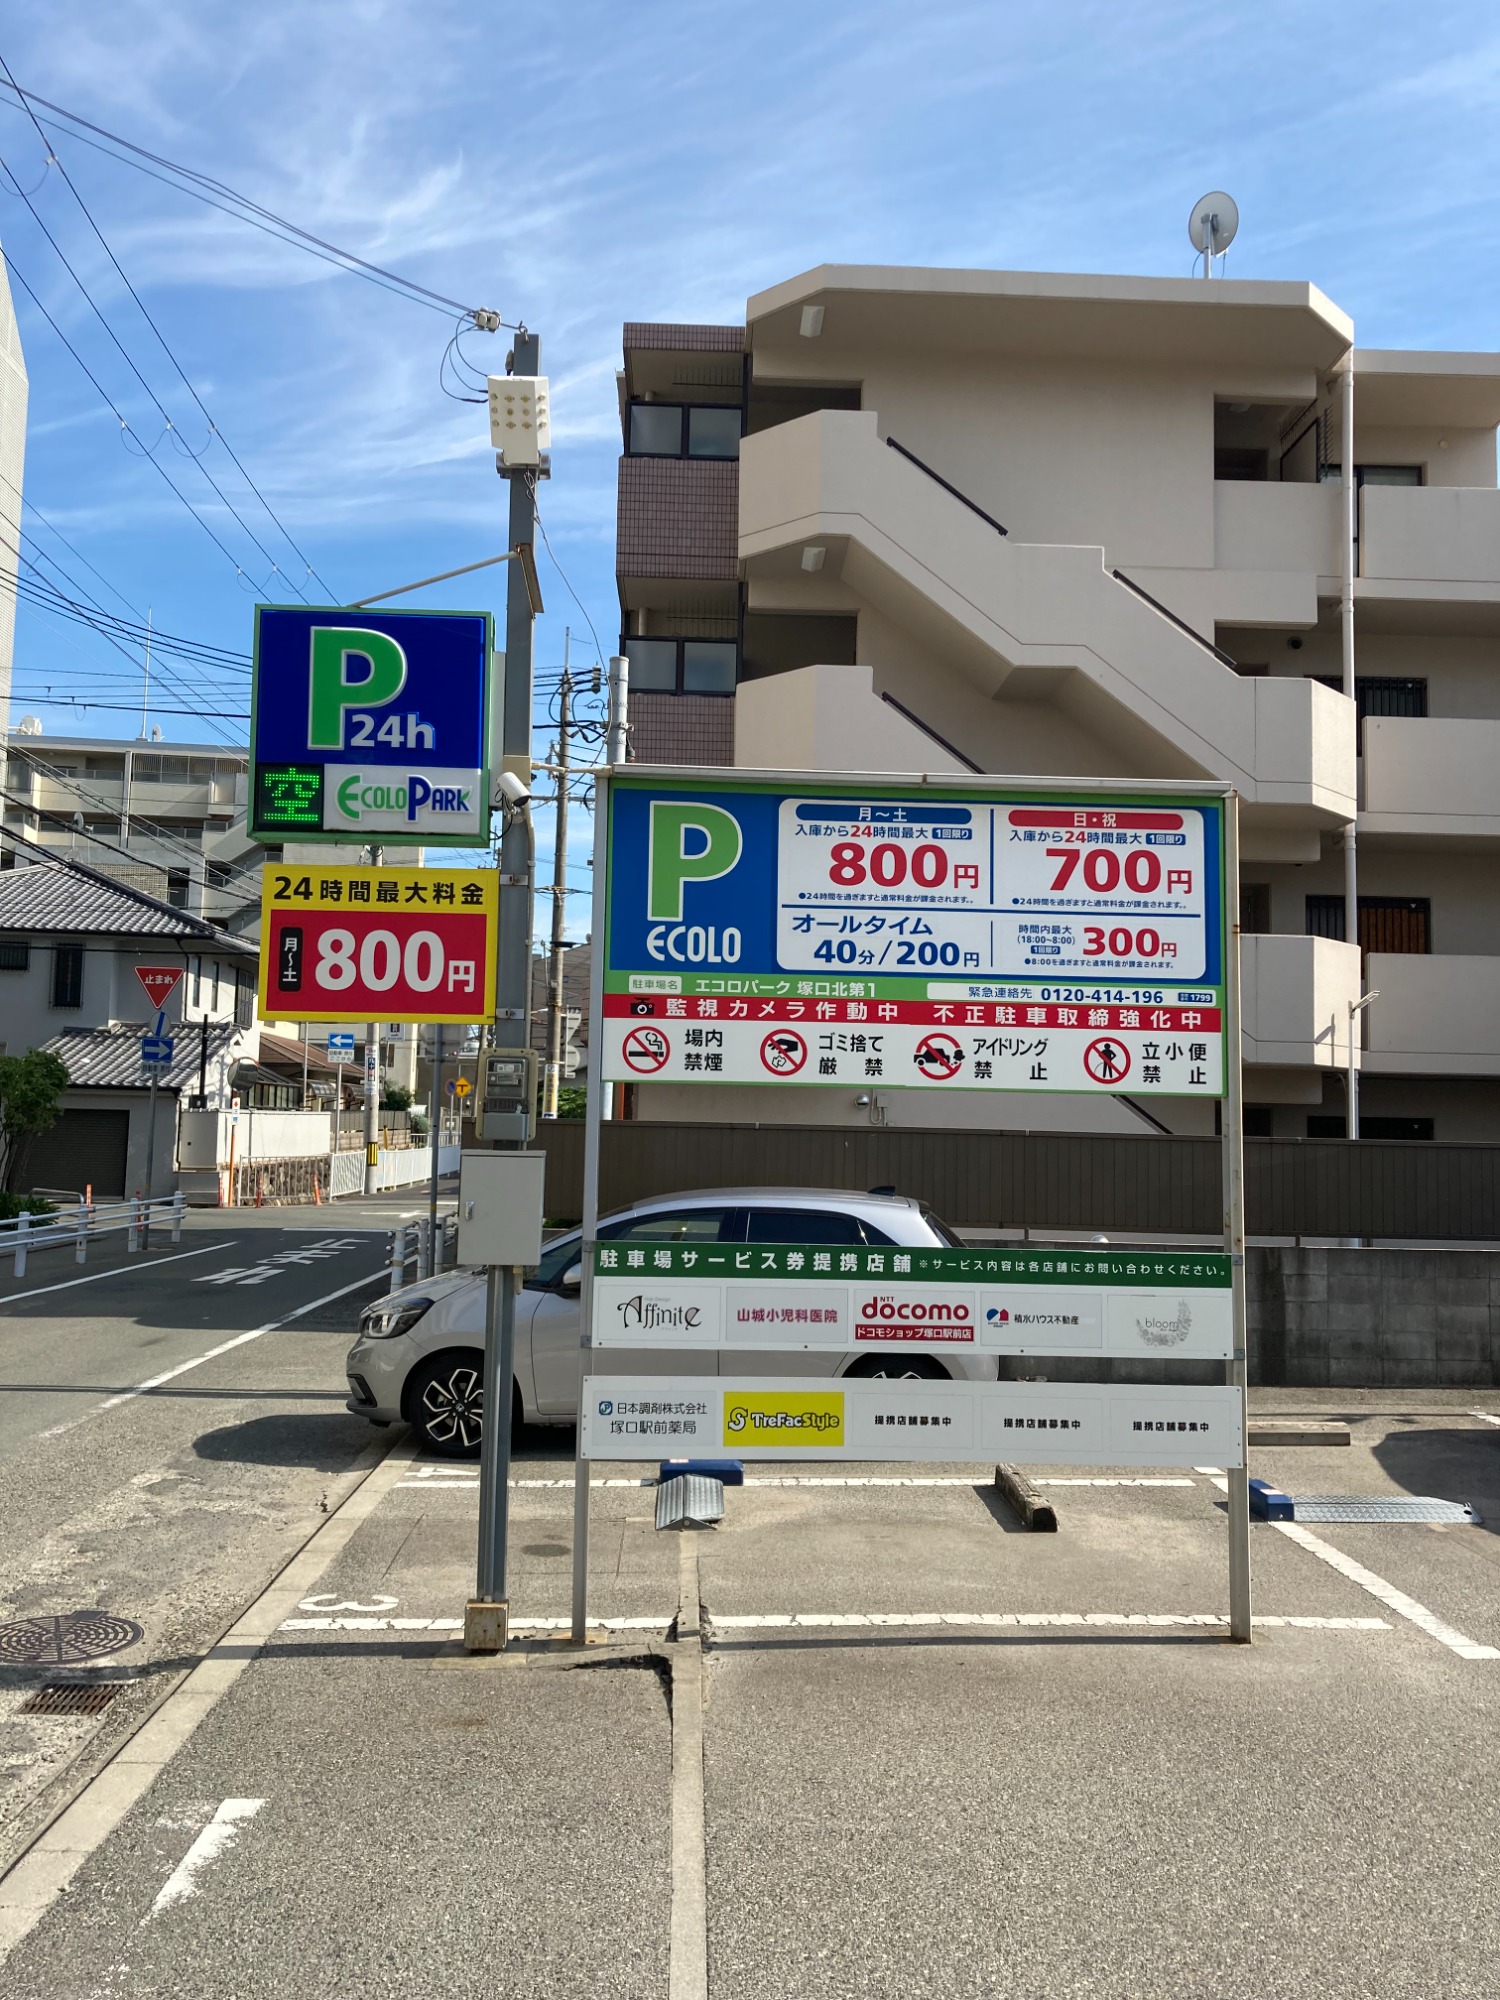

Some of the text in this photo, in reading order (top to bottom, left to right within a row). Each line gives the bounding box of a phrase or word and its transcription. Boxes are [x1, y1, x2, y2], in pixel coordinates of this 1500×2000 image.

[307, 625, 408, 750] P
[349, 711, 436, 750] 24h
[263, 767, 320, 822] 空
[1073, 812, 1117, 828] 日・祝
[795, 823, 970, 840] 入庫から24時間最大 1回限り
[1009, 829, 1183, 846] 入庫から24時間最大 1回限り
[647, 800, 743, 922] P
[829, 841, 979, 890] 800円
[1046, 848, 1193, 895] 700円
[273, 875, 485, 906] 24時間最大料金
[792, 913, 934, 936] オールタイム
[1018, 924, 1073, 936] 時間内最大
[646, 924, 742, 964] ECOLO
[1082, 927, 1177, 958] 300円
[315, 928, 476, 993] 800円
[145, 974, 174, 985] 止まれ
[632, 978, 679, 991] 駐車場名
[696, 979, 876, 998] エコロパーク 塚口北第1
[968, 986, 1033, 1000] 緊急連絡先
[1041, 987, 1164, 1004] 0120-414-196
[1190, 994, 1212, 1002] 1799
[665, 998, 899, 1022] 監視カメラ作動中
[933, 1004, 1202, 1030] 不正駐車取締強化中
[684, 1028, 723, 1048] 場内
[819, 1033, 885, 1054] ゴミ捨て
[972, 1037, 1049, 1057] アイドリング
[1142, 1042, 1207, 1062] 立小便
[684, 1053, 723, 1072] 禁煙
[599, 1249, 911, 1274] 駐車場サービス券提携店舗
[737, 1308, 838, 1324] 山城小児科医院
[862, 1296, 969, 1321] docomo
[1014, 1314, 1080, 1326] 積水ハウス不動産
[1145, 1317, 1179, 1329] bloom
[857, 1326, 972, 1340] ドコモショップ塚口駅前店
[617, 1402, 707, 1416] 日本調剤株式会社
[610, 1420, 697, 1435] 塚口駅前薬局
[751, 1412, 840, 1432] TreFacStyle
[874, 1415, 952, 1427] 提携店舗募集中
[1003, 1418, 1081, 1430] 提携店舗募集中
[1133, 1421, 1210, 1433] 提携店舗募集中
[298, 1593, 400, 1612] 3
